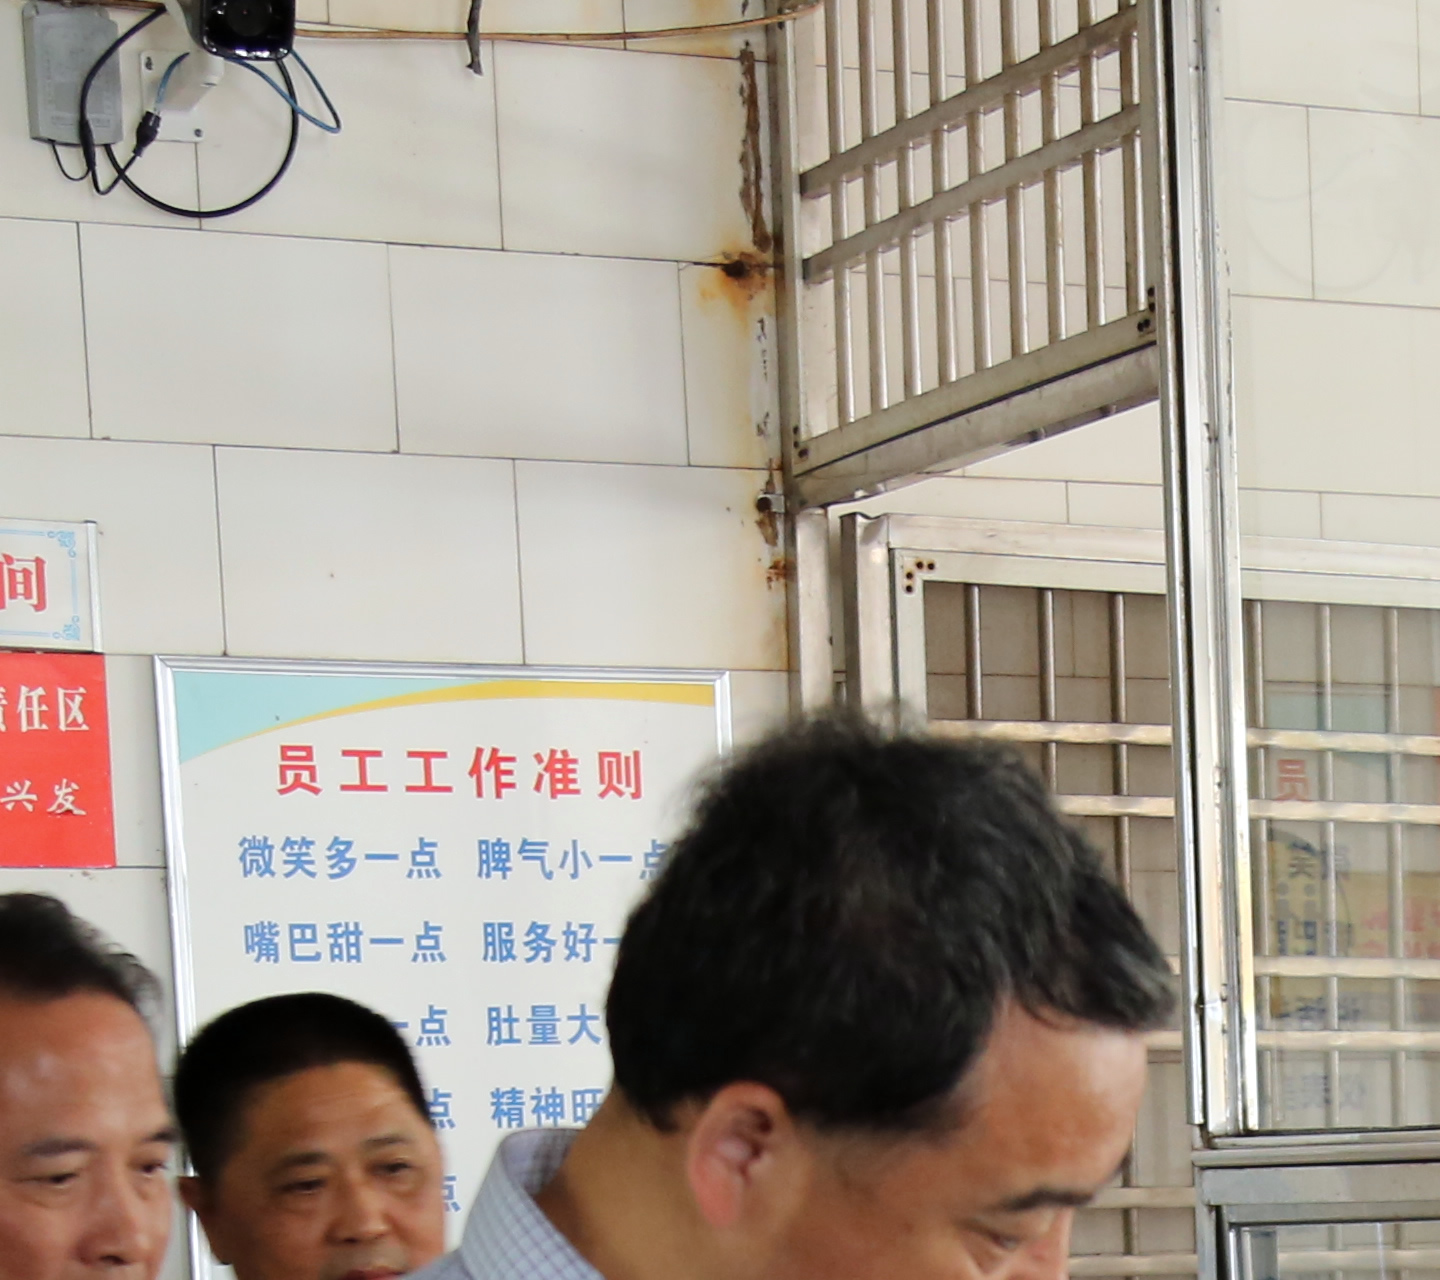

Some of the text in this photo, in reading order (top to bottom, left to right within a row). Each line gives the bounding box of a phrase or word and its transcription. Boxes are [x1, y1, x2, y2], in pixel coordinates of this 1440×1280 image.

[276, 744, 643, 800] 员工工作准则
[238, 835, 443, 880] 微笑多一点
[243, 920, 447, 963] 嘴巴甜一点
[486, 1003, 602, 1046] 肚量大
